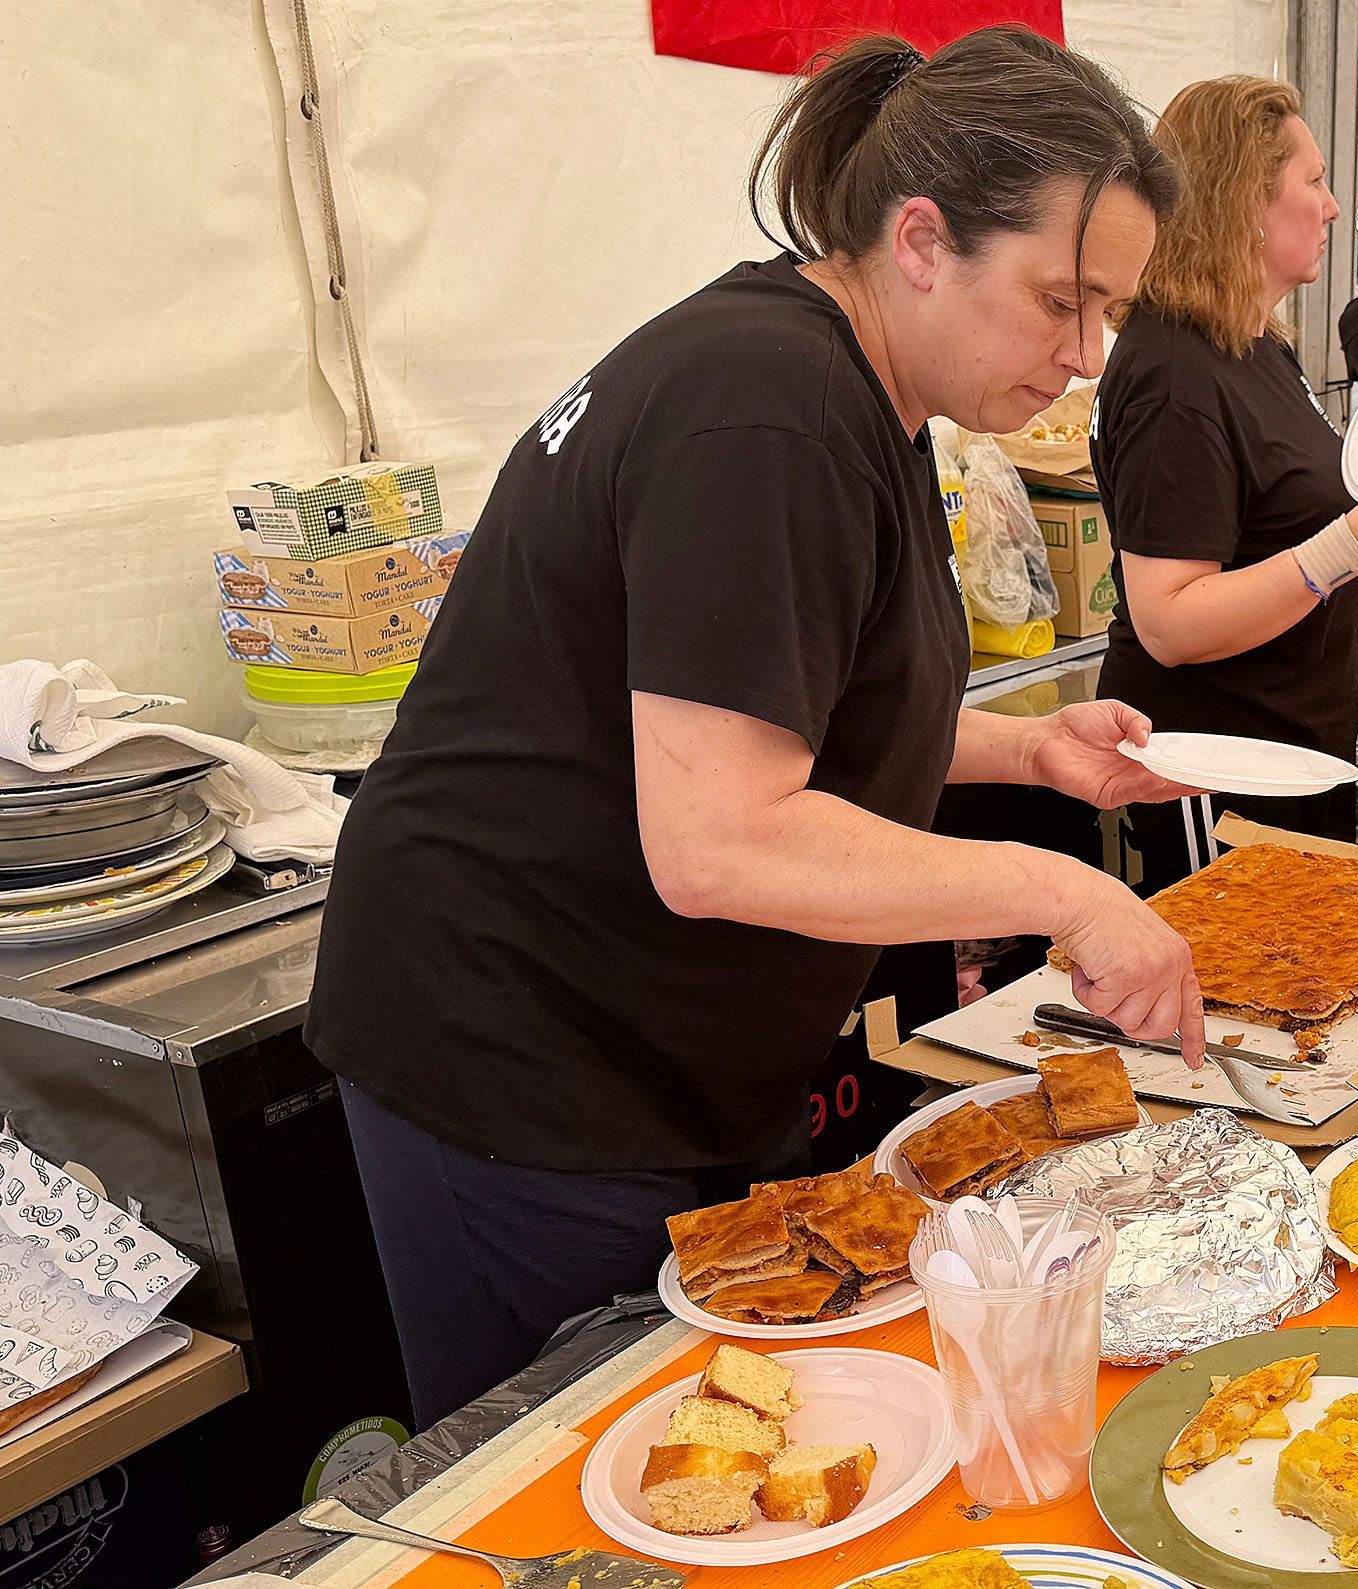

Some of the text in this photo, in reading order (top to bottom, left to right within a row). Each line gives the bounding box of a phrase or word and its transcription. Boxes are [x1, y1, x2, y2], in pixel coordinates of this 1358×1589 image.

[281, 587, 344, 600] YOGUR YOGHURT
[360, 574, 434, 602] YOGUR YOGHURT
[363, 644, 394, 660] YOGUR
[318, 1418, 384, 1463] COMPROMETIDOS
